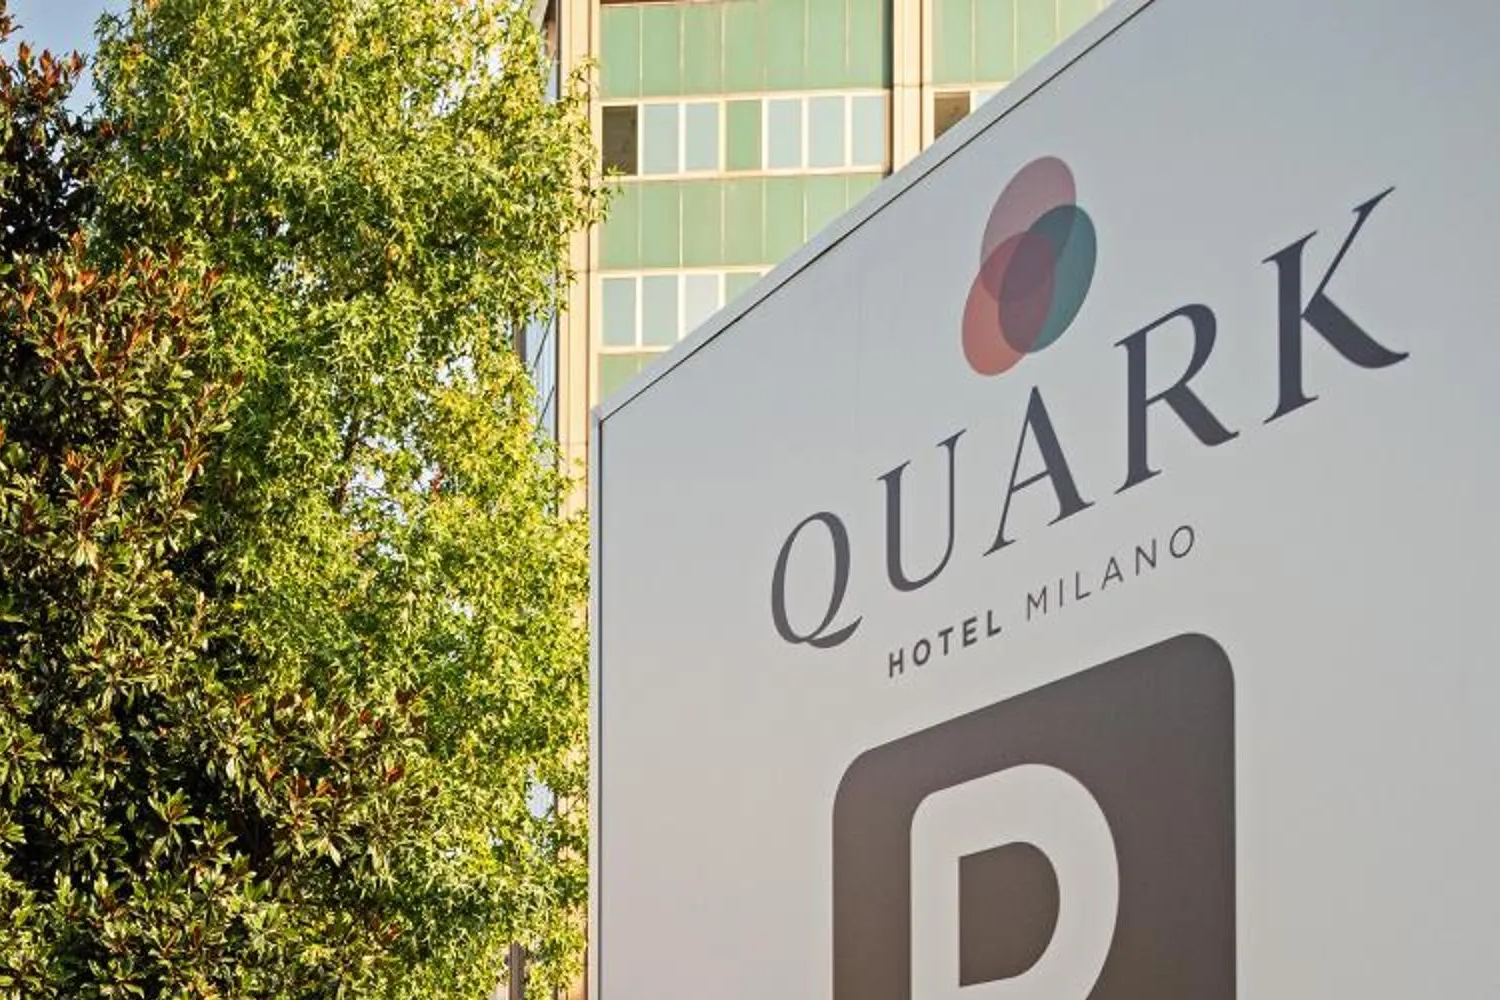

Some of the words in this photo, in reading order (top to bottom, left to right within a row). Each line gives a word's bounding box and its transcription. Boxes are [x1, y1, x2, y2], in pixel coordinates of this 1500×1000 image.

[771, 186, 1409, 648] QUARK
[887, 609, 1003, 678] HOTEL
[1026, 524, 1196, 621] MILANO
